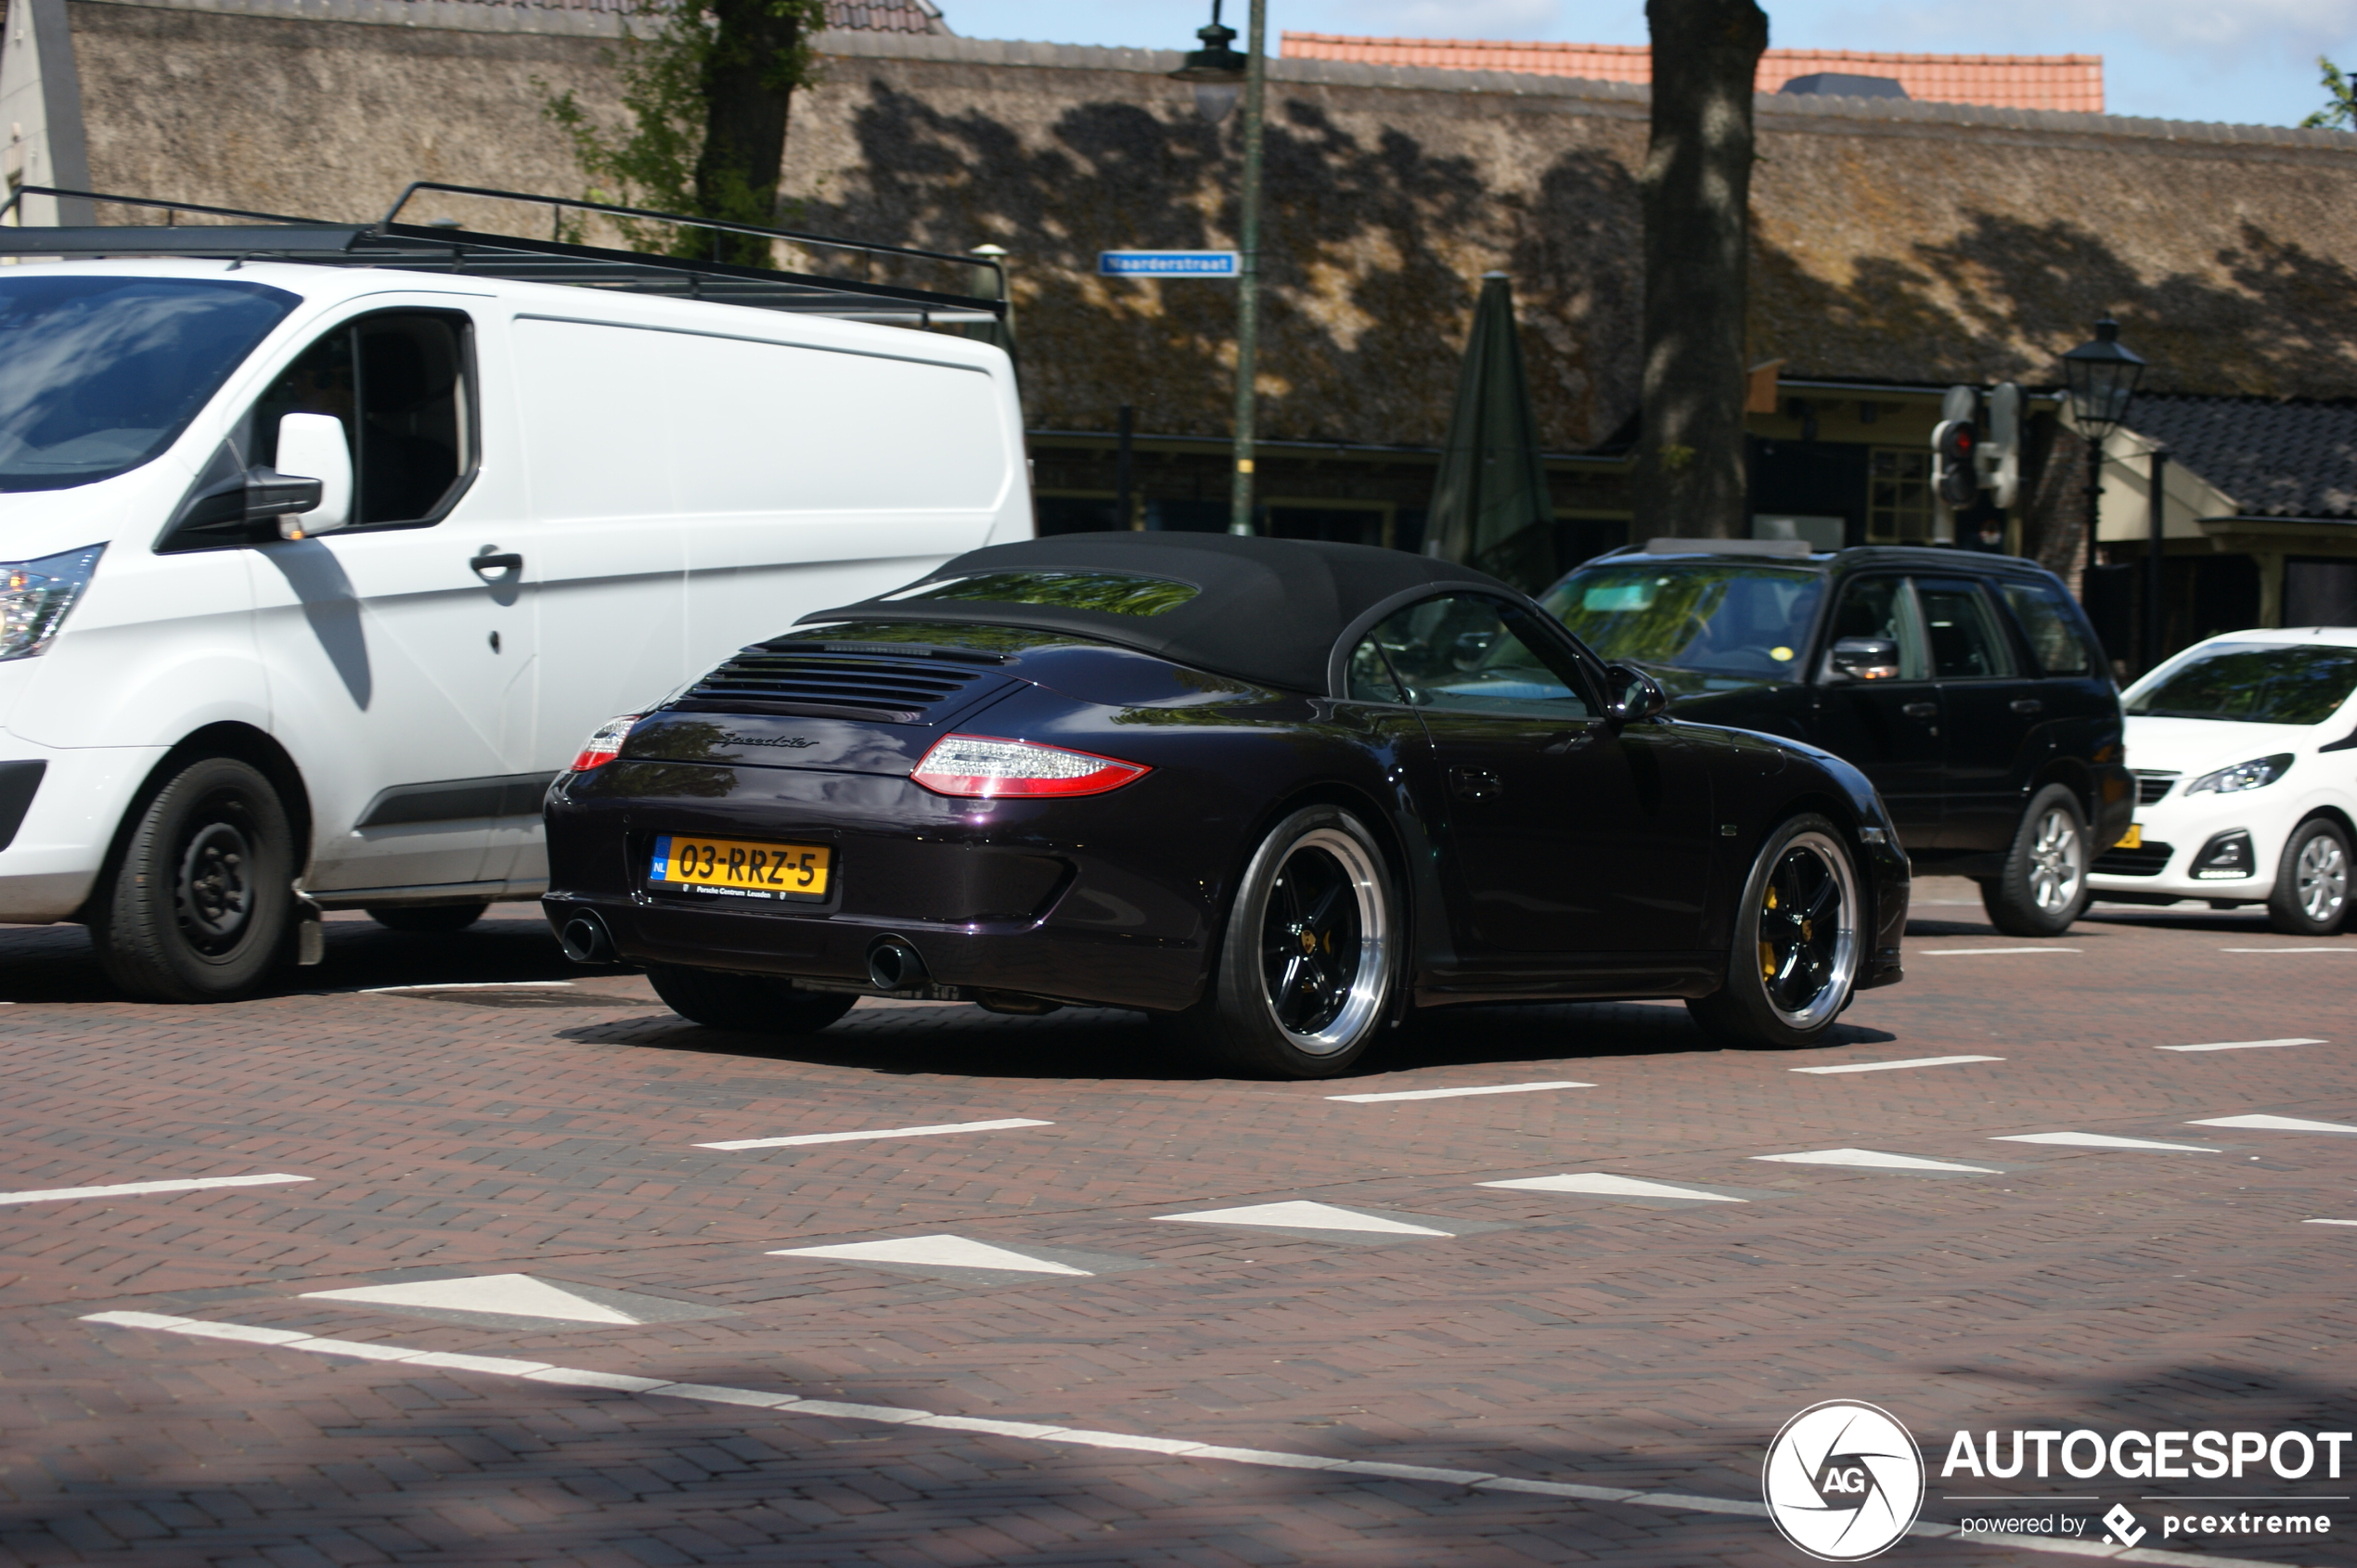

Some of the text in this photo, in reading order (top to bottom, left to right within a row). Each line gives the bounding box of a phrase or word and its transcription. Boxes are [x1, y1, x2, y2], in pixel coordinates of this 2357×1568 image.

[653, 862, 665, 873] NL
[679, 844, 816, 887] 03-RRZ-5
[697, 885, 771, 899] Porsche Centrum Leusden
